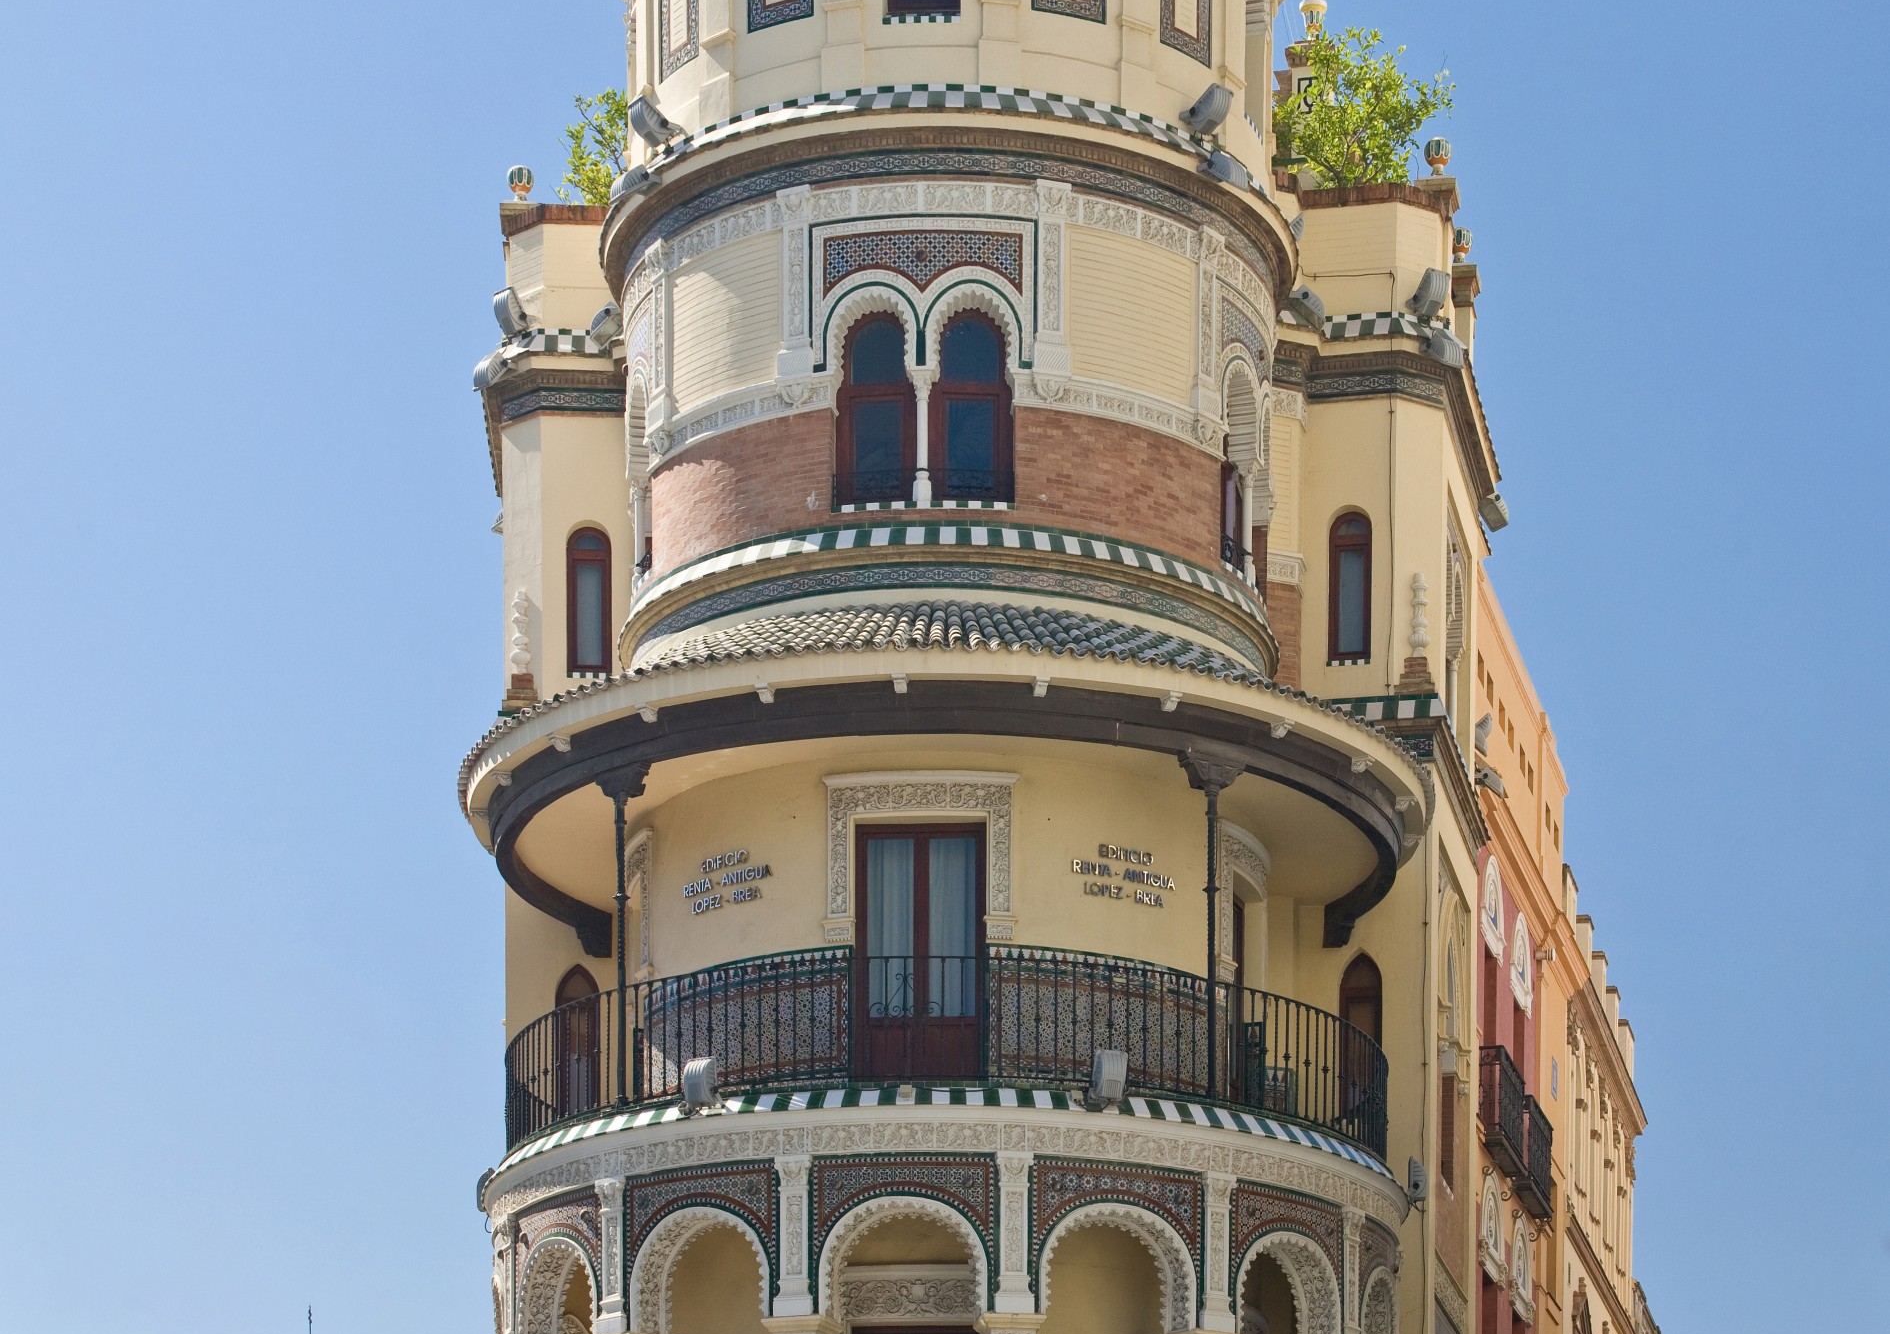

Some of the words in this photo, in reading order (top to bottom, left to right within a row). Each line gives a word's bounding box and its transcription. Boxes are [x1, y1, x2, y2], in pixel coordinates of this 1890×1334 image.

[700, 849, 750, 873] EDIFICIO
[1098, 843, 1154, 866] EDIFICIO
[683, 877, 712, 898] RENTA
[720, 864, 773, 887] ANTIGUA
[1072, 859, 1112, 878] RENTA
[1123, 867, 1176, 891] ANTIGUA
[691, 894, 722, 915] LOPEZ
[732, 886, 763, 904] BREA
[1083, 880, 1124, 899] LOPEZ
[1134, 889, 1164, 908] BREA
